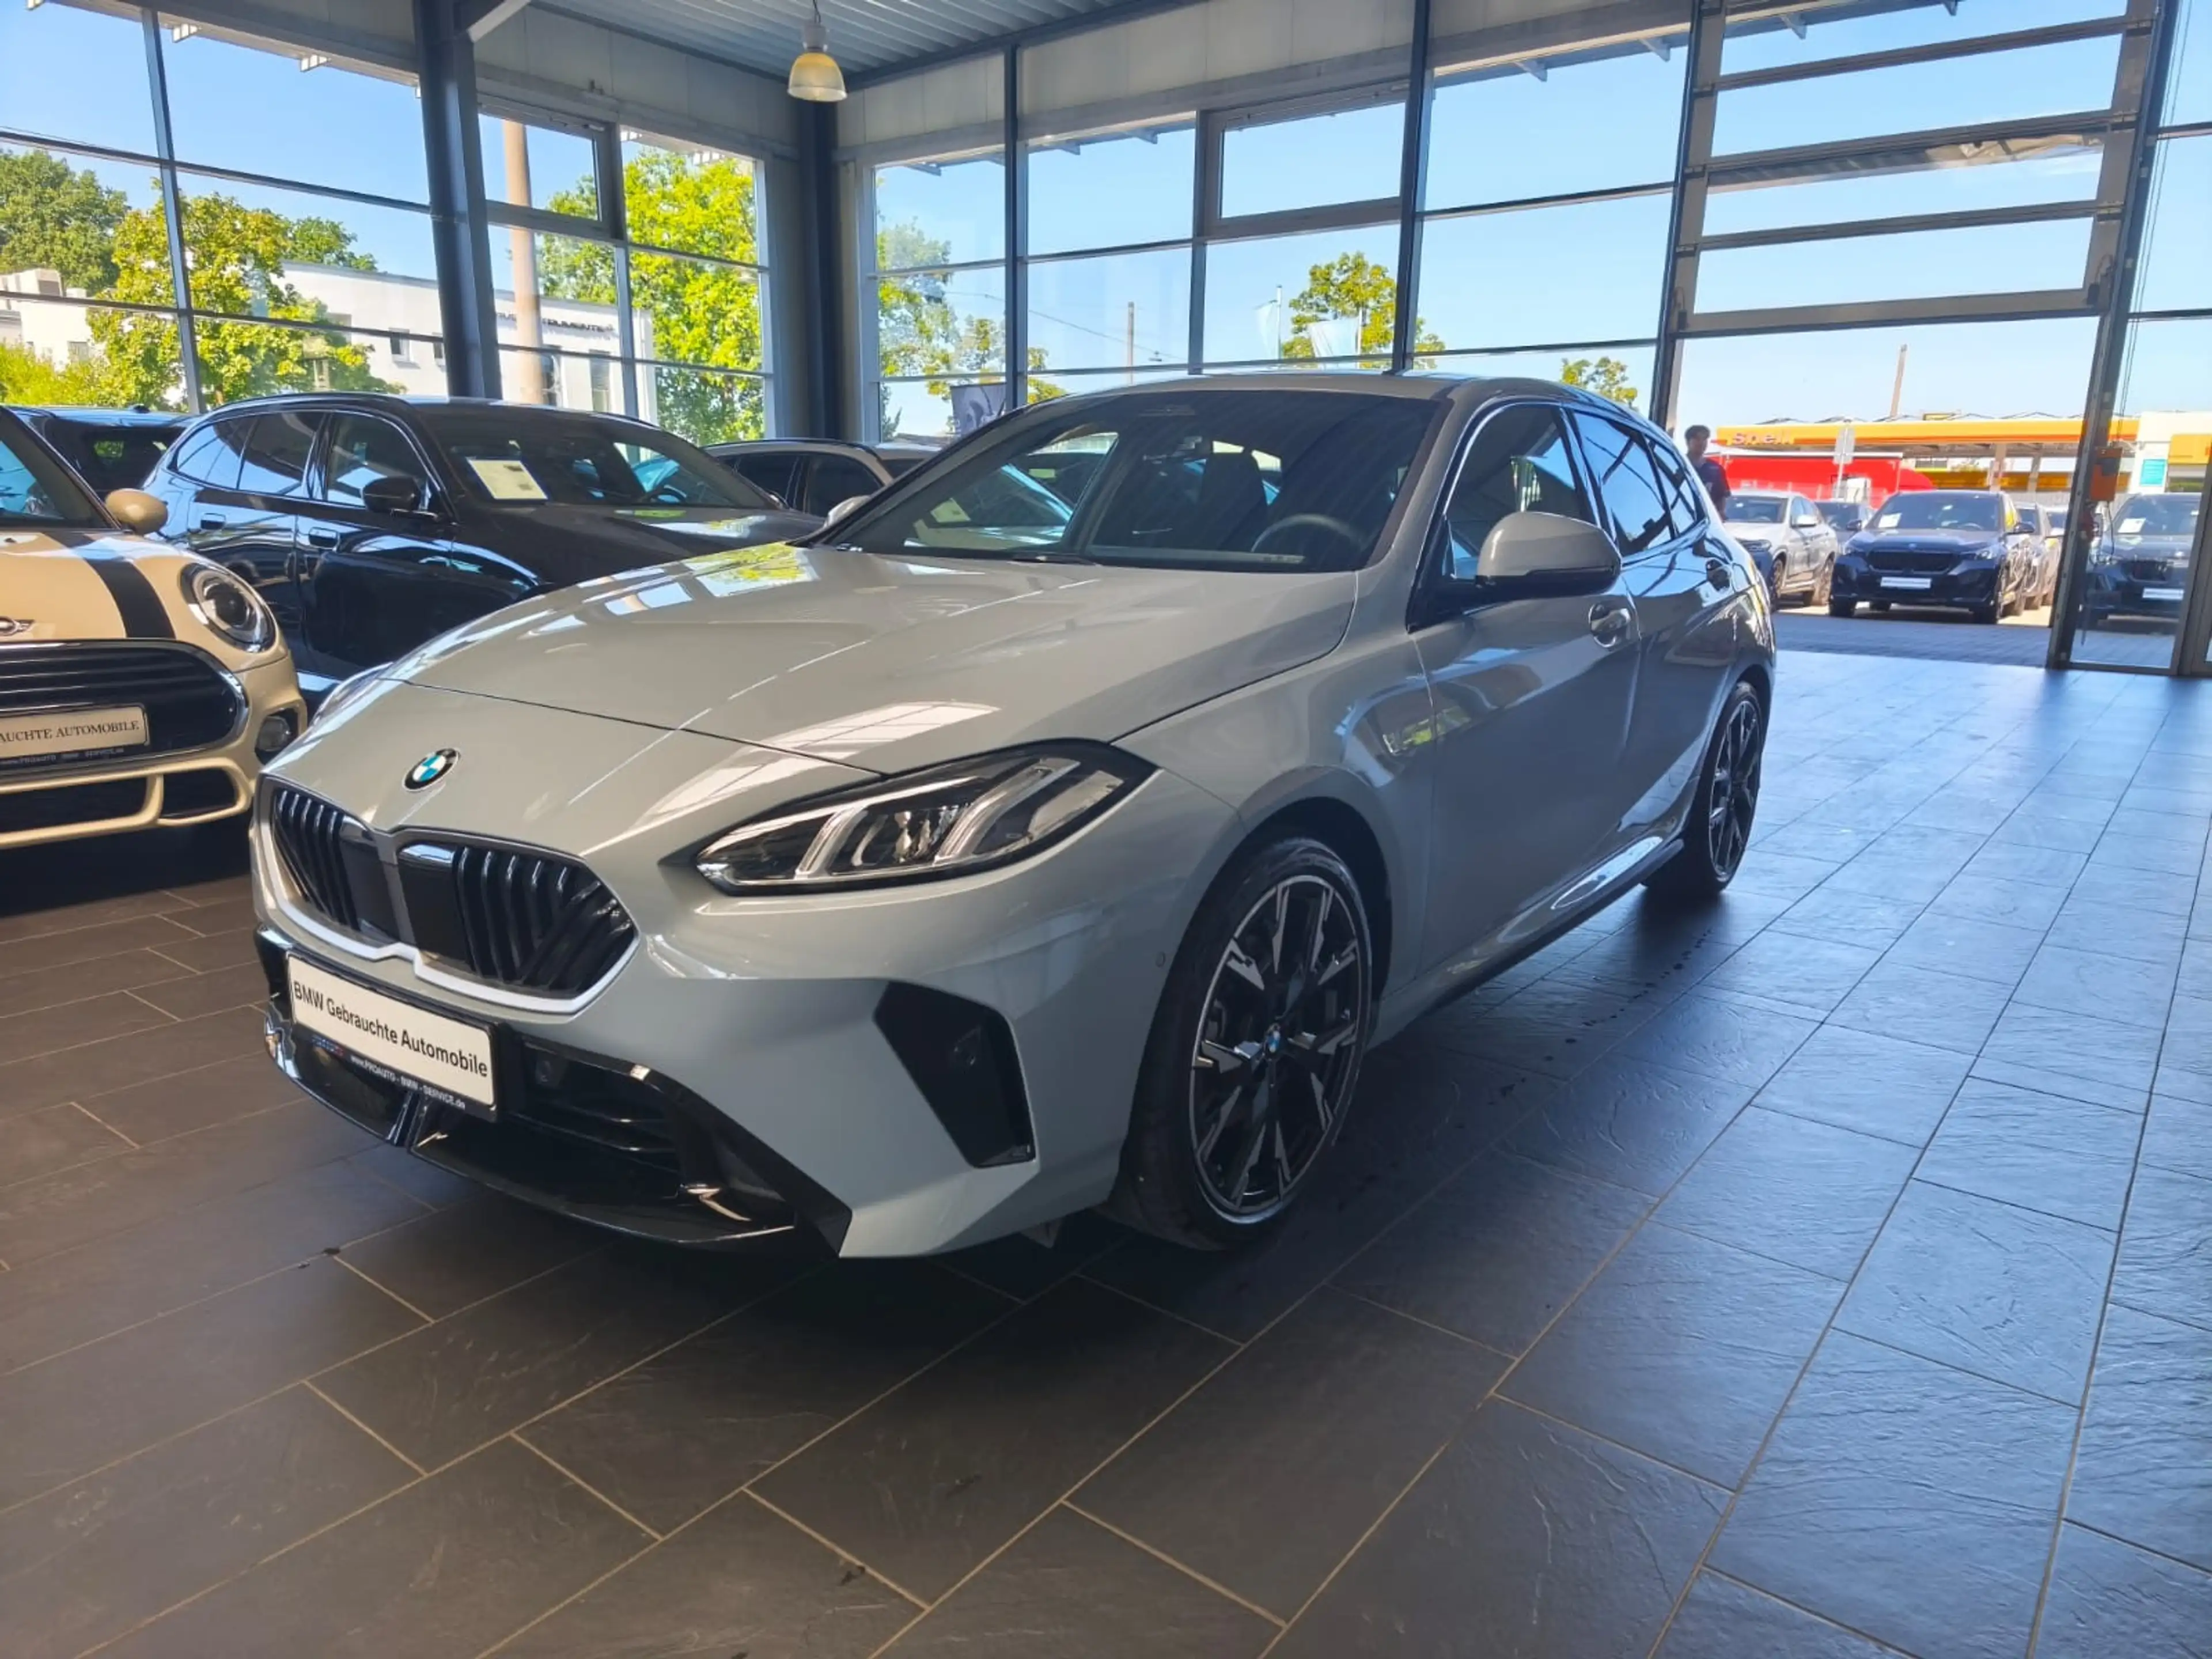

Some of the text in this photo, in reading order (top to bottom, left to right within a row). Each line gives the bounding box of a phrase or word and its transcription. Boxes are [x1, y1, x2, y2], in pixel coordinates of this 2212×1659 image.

[56, 720, 139, 738] AUTOMOBILE
[293, 980, 487, 1077] BMW Gebrauchte Automobile
